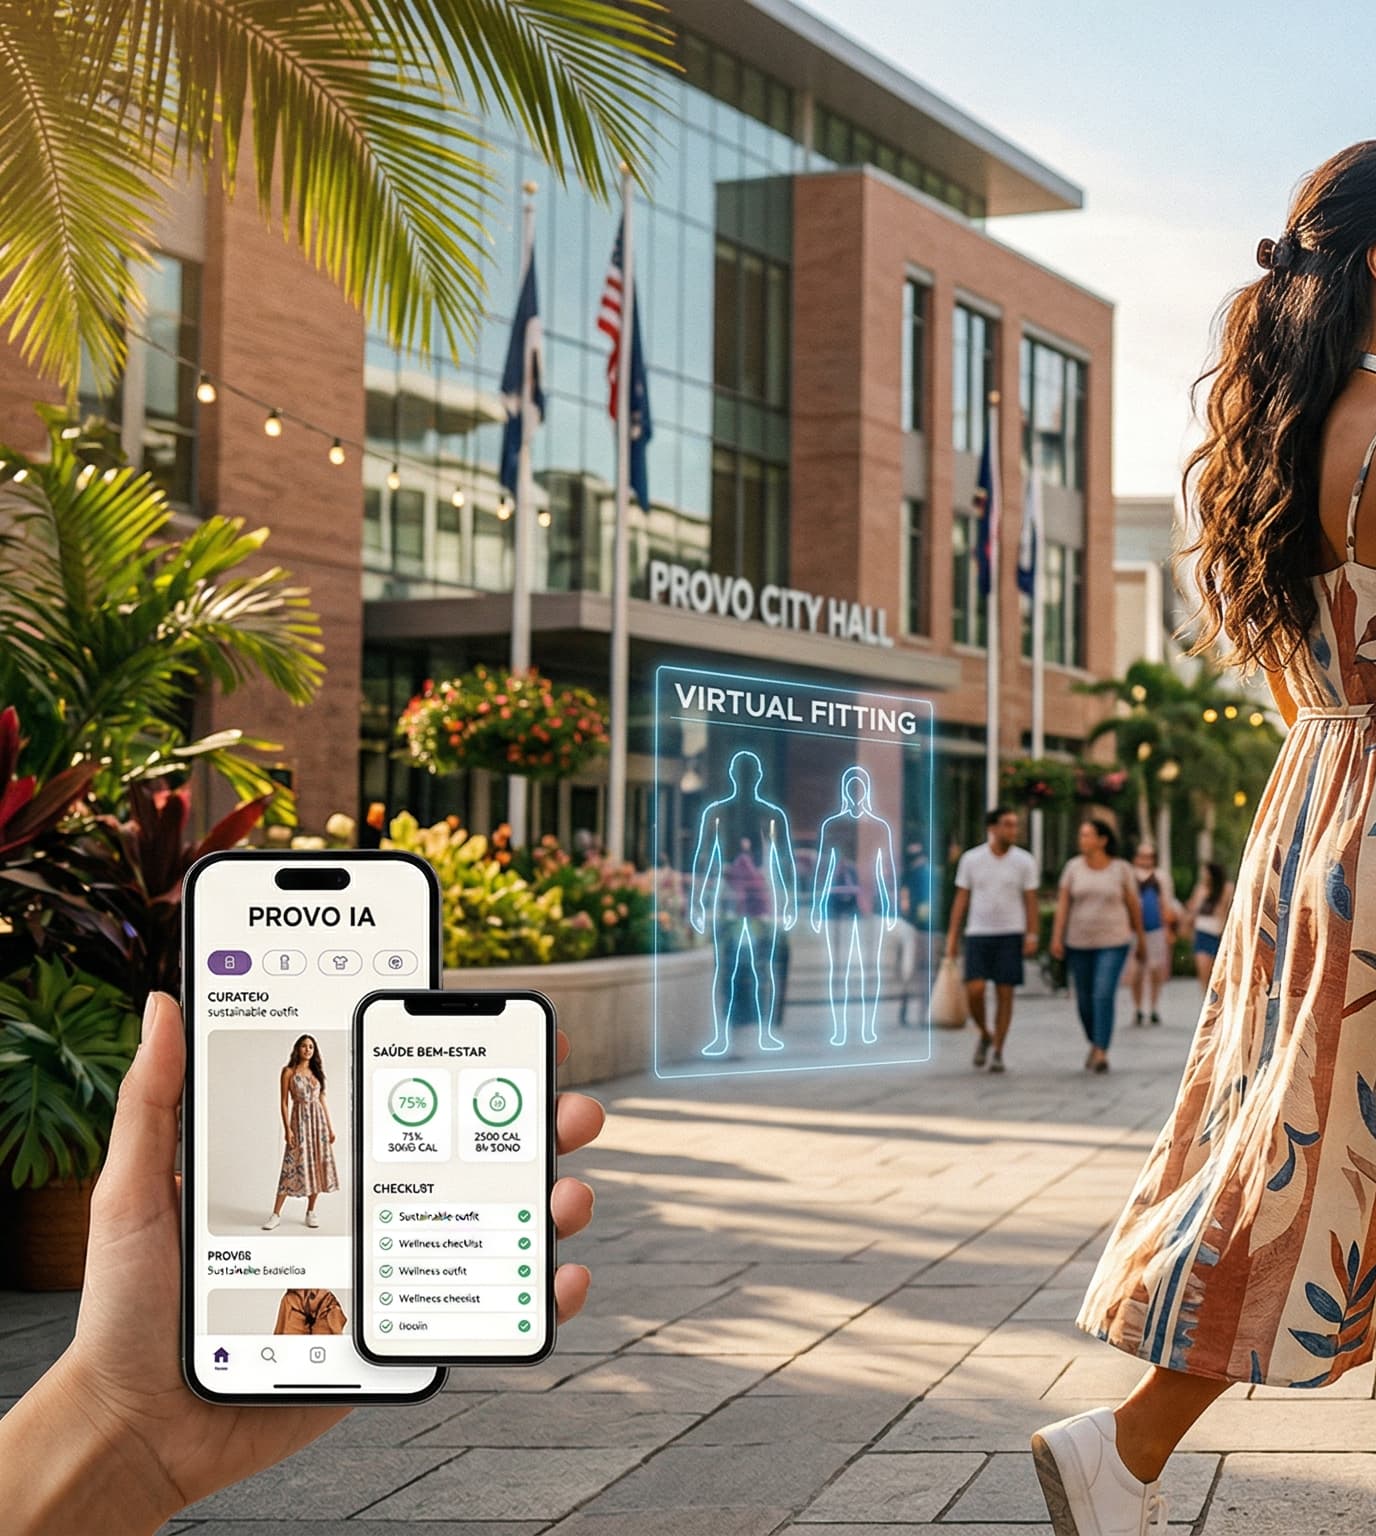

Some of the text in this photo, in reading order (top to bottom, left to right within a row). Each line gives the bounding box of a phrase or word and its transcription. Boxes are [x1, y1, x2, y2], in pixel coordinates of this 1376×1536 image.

[649, 559, 895, 648] PROVO CITY HALL
[674, 682, 917, 735] VIRTUAL FITTING
[249, 906, 376, 928] PROVO IA
[373, 1044, 487, 1058] SAÚDE BEM-ESTAR
[398, 1096, 427, 1110] 75%
[474, 1131, 521, 1142] 2500 CAL
[418, 1143, 439, 1153] CAL
